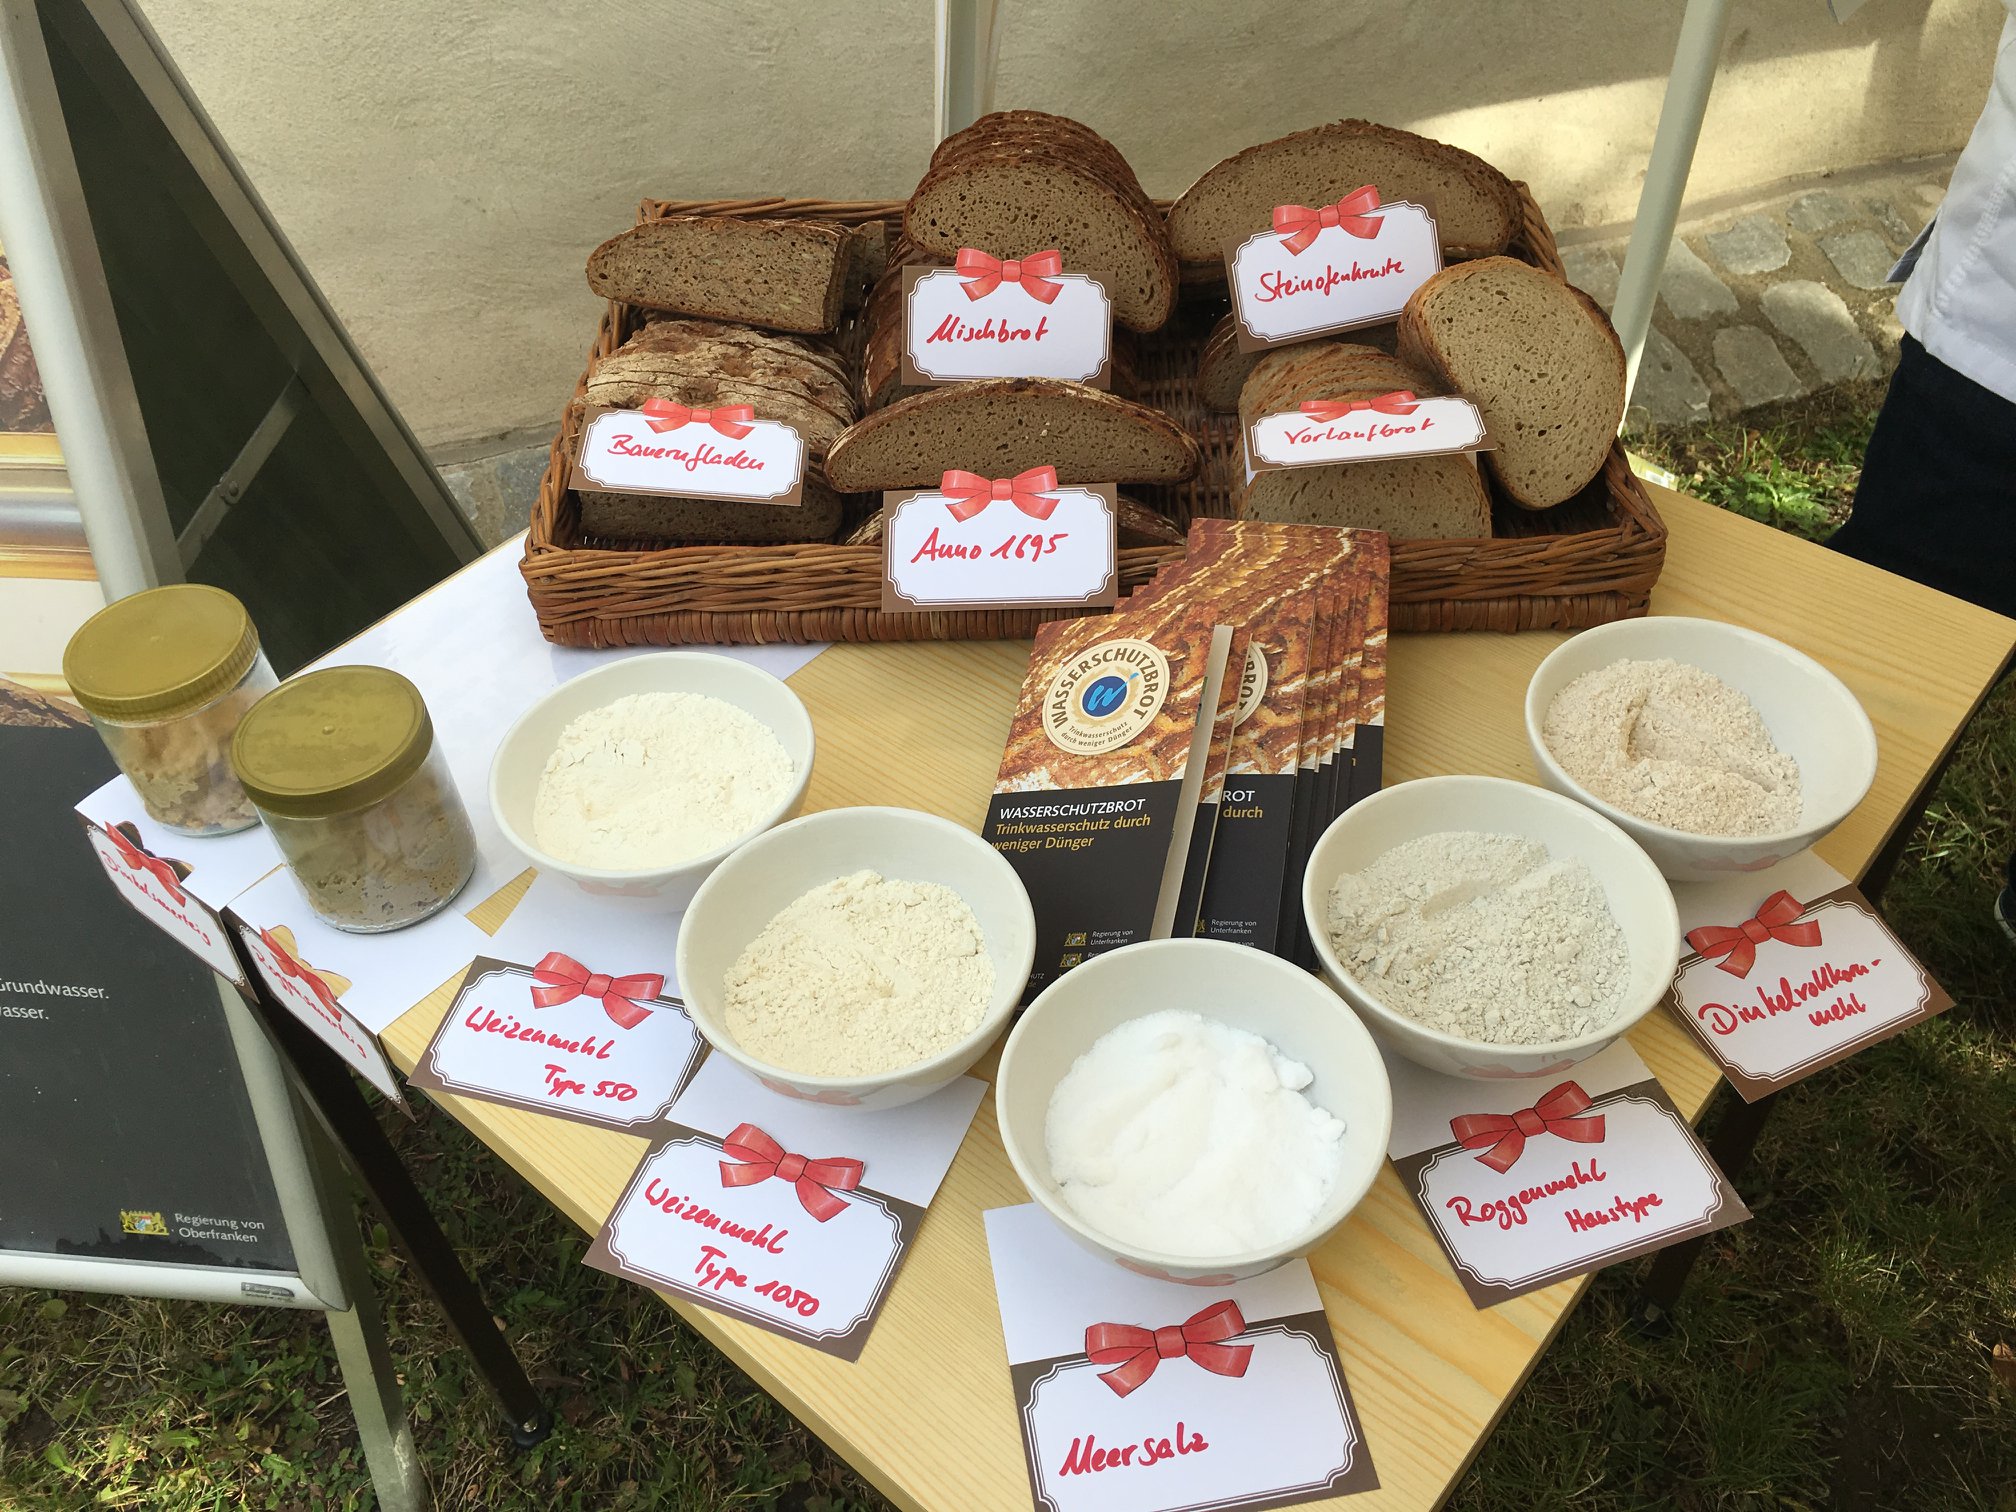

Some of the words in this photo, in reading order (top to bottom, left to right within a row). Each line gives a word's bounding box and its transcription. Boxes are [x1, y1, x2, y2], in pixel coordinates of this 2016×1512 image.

[1254, 257, 1405, 302] Steinofenkruste
[927, 313, 1049, 344] Mischbrot
[1284, 417, 1435, 445] Vorlaufbrot
[607, 433, 766, 472] Bauernfladen
[911, 527, 982, 563] Anno
[990, 533, 1068, 562] 1695
[1051, 647, 1160, 730] WASSERSCHUTZBROT
[1061, 732, 1077, 744] durch
[1078, 739, 1106, 748] weniger
[1107, 726, 1133, 744] Dünger
[1069, 721, 1129, 739] Trinkwasserschutz
[1000, 798, 1146, 820] WASSERSCHUTZBROT
[1222, 805, 1263, 819] durch
[996, 819, 1110, 836] Trinkwasserschutz
[1114, 814, 1151, 830] durch
[991, 838, 1043, 853] weniger
[1045, 836, 1095, 852] Dünger
[1092, 930, 1121, 940] Regierung
[1211, 919, 1243, 927] Regierung
[0, 1006, 49, 1020] asser.
[1808, 993, 1867, 1028] mehl
[464, 1005, 614, 1060] Weizenmehl
[544, 1064, 585, 1097] Type
[593, 1080, 638, 1102] 550
[1446, 1158, 1607, 1230] Roggenmehl
[174, 1213, 239, 1230] Regierung
[241, 1219, 265, 1230] von
[644, 1178, 788, 1256] Weizenmehl
[1563, 1192, 1663, 1232] Haustype
[178, 1226, 258, 1243] Oberfranken
[694, 1245, 747, 1290] Type
[753, 1281, 820, 1317] 1050
[1058, 1421, 1209, 1477] Meersalz
